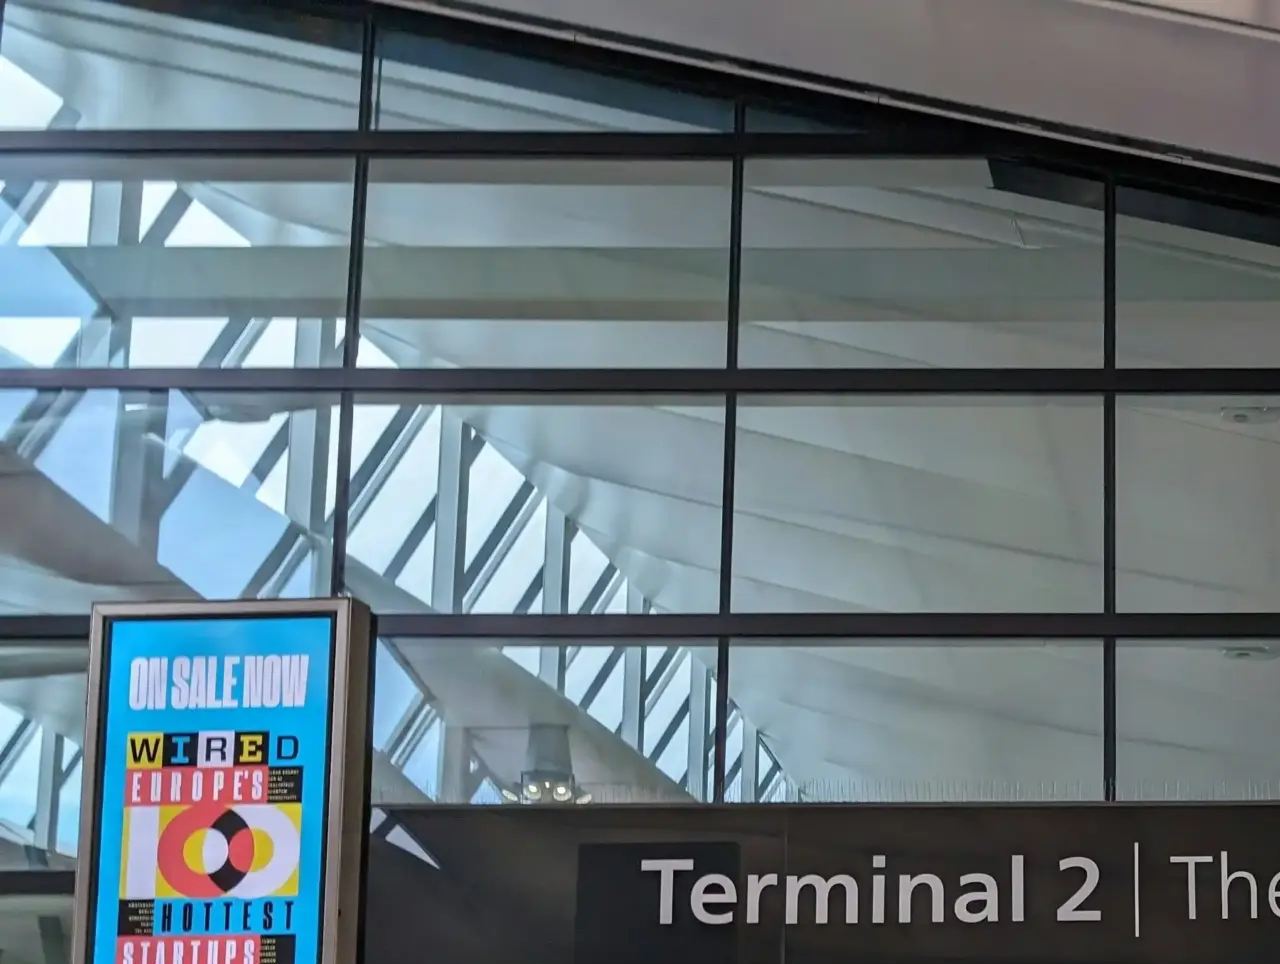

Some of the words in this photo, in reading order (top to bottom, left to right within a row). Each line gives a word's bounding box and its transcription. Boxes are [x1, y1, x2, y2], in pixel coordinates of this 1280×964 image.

[128, 656, 168, 711] ON
[171, 655, 240, 710] SALE
[242, 654, 310, 708] NOW
[130, 735, 299, 765] WIRED
[131, 769, 264, 803] EUROPE'S
[126, 804, 301, 900] 100
[641, 854, 1026, 926] Terminal
[1056, 856, 1102, 922] 2
[161, 901, 294, 932] HOTTEST
